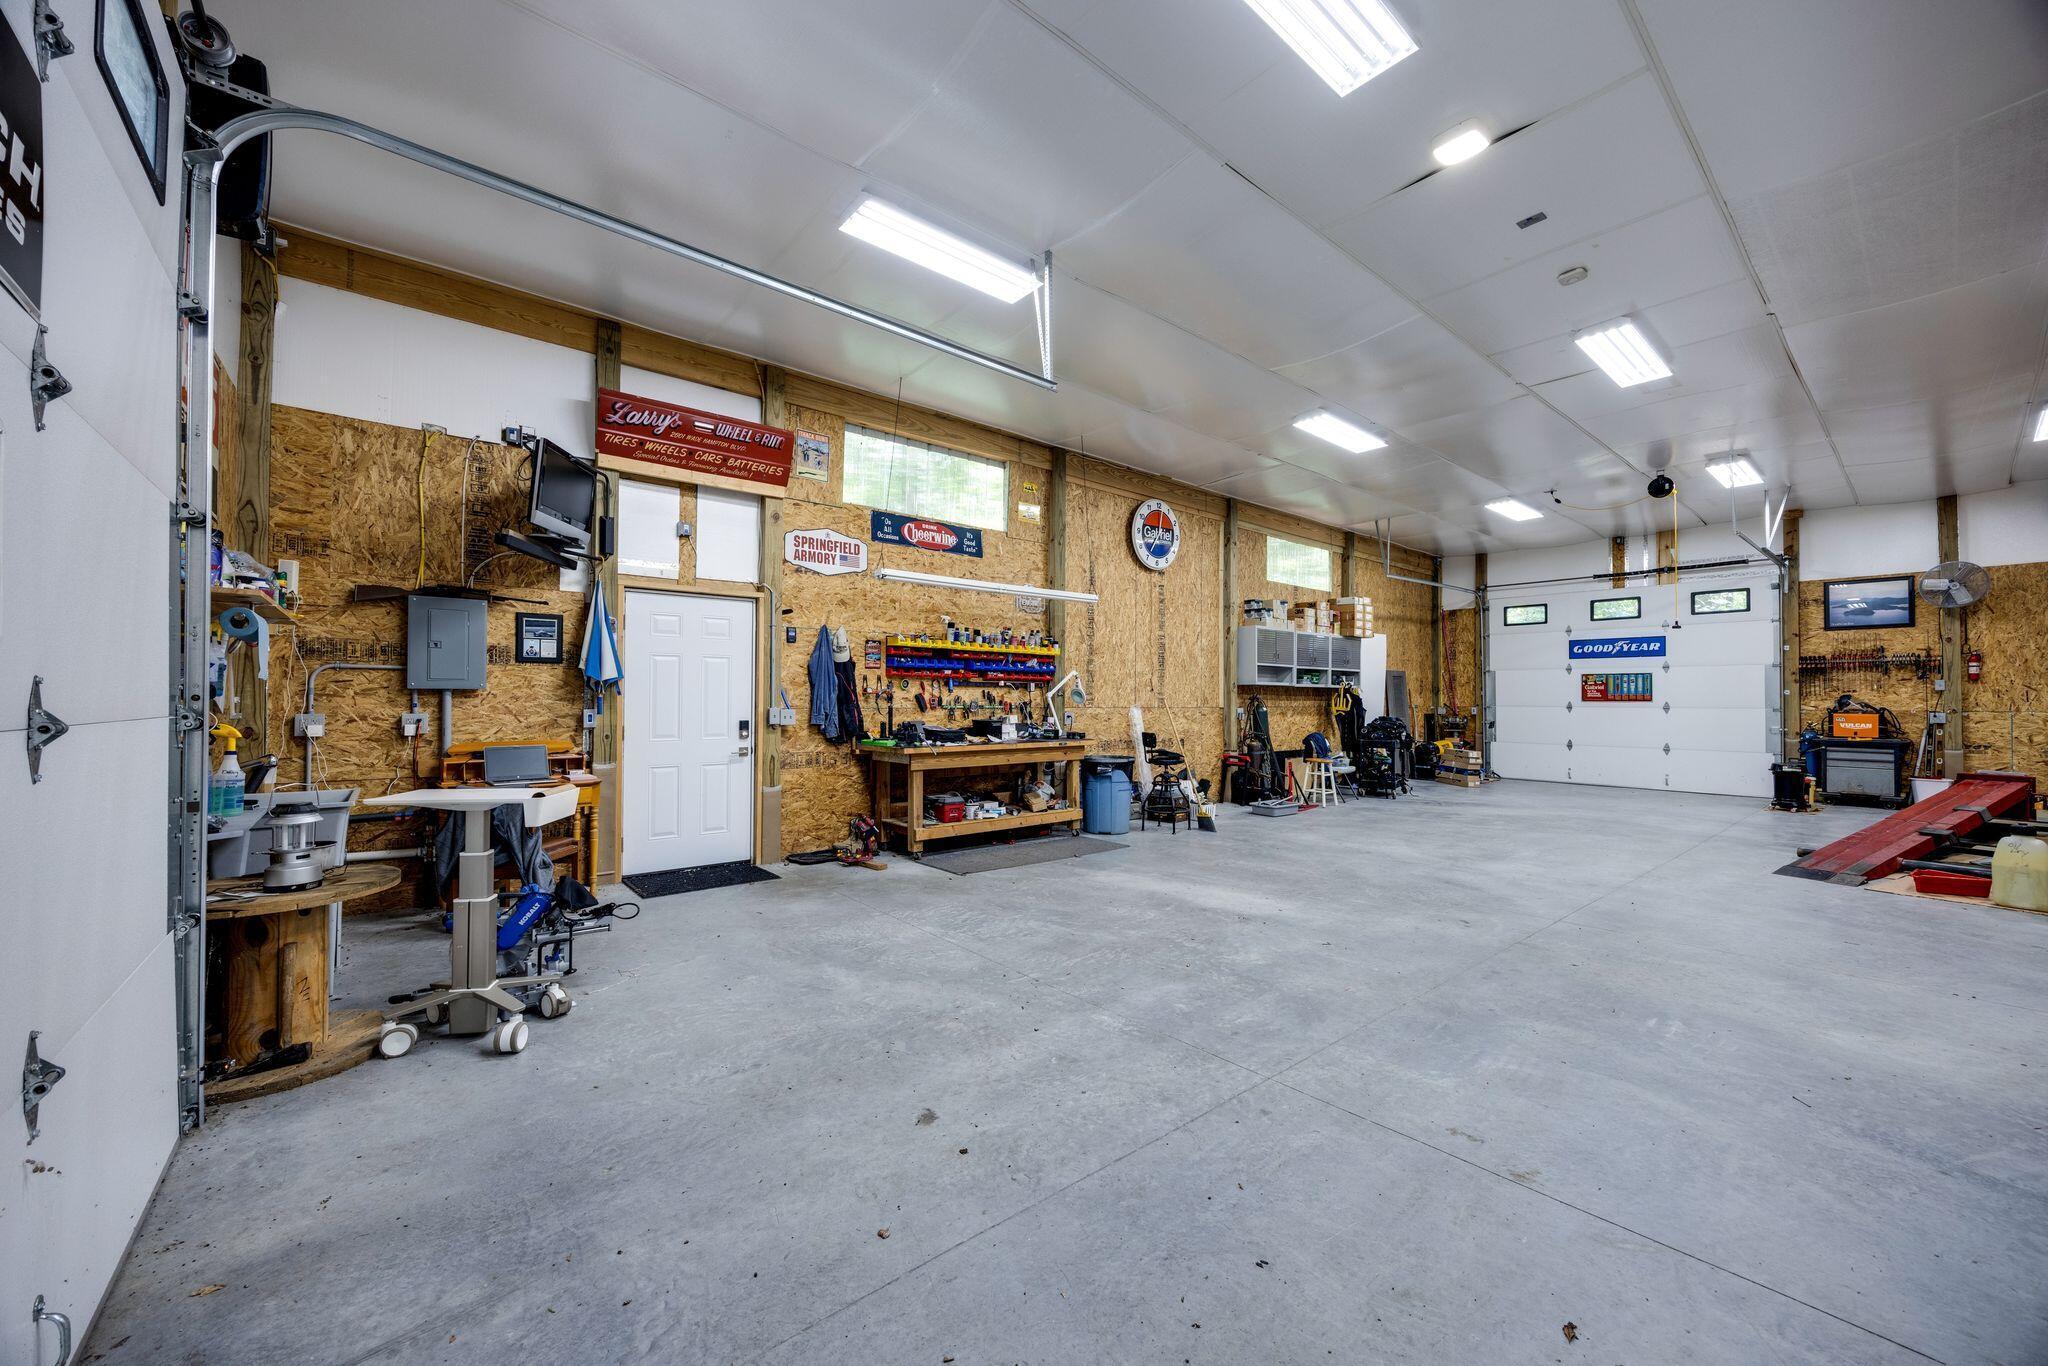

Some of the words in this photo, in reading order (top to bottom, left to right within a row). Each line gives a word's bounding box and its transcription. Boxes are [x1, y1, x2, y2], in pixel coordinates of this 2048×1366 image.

[605, 402, 682, 436] Larry's
[716, 424, 752, 443] WHEEL
[755, 433, 761, 442] &
[761, 434, 785, 450] RIM
[703, 438, 729, 448] HAMPTON
[604, 434, 639, 447] TIRES
[645, 441, 688, 457] WHEELS
[695, 451, 723, 464] CARS
[727, 458, 784, 476] BATTERIES
[633, 450, 660, 461] Special
[660, 456, 680, 464] Orders
[688, 461, 717, 473] Financing
[877, 531, 899, 541] Occasions
[904, 522, 958, 546] Cheerwine
[963, 539, 976, 547] Good
[793, 535, 860, 555] SPRINGFIELD
[793, 549, 837, 565] ARMORY
[518, 902, 541, 926] KOBALT
